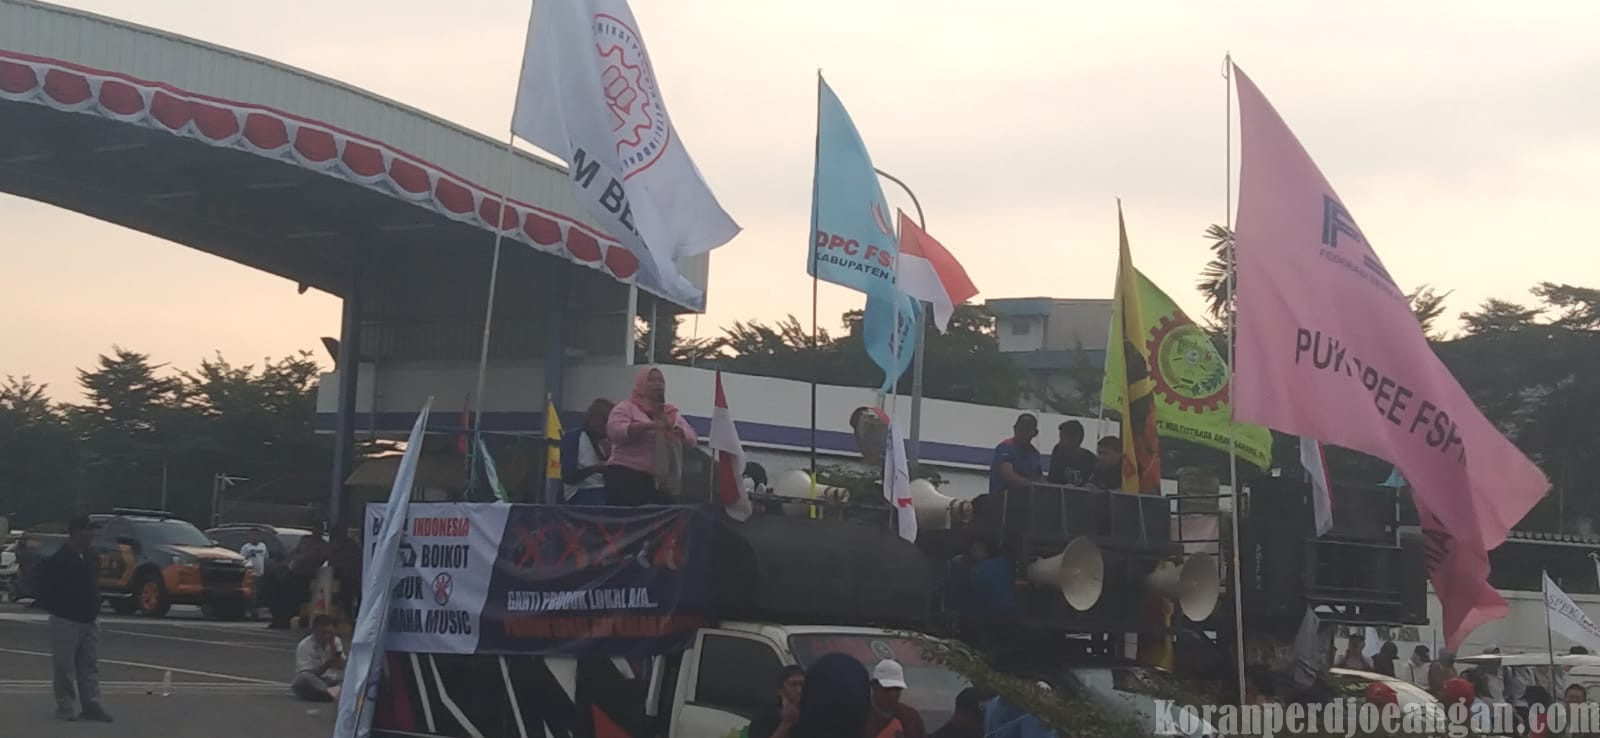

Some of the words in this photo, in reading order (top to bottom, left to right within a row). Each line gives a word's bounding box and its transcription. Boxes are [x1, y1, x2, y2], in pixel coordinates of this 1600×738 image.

[817, 230, 860, 256] DPC
[864, 244, 894, 270] FS
[816, 252, 889, 280] KABUPATEN
[413, 517, 470, 537] INDONESIA
[421, 544, 470, 569] BOIKOT
[507, 590, 541, 611] GANTI
[541, 590, 588, 611] PRODUK
[588, 588, 626, 610] LOKAL
[425, 609, 472, 635] MUSIC
